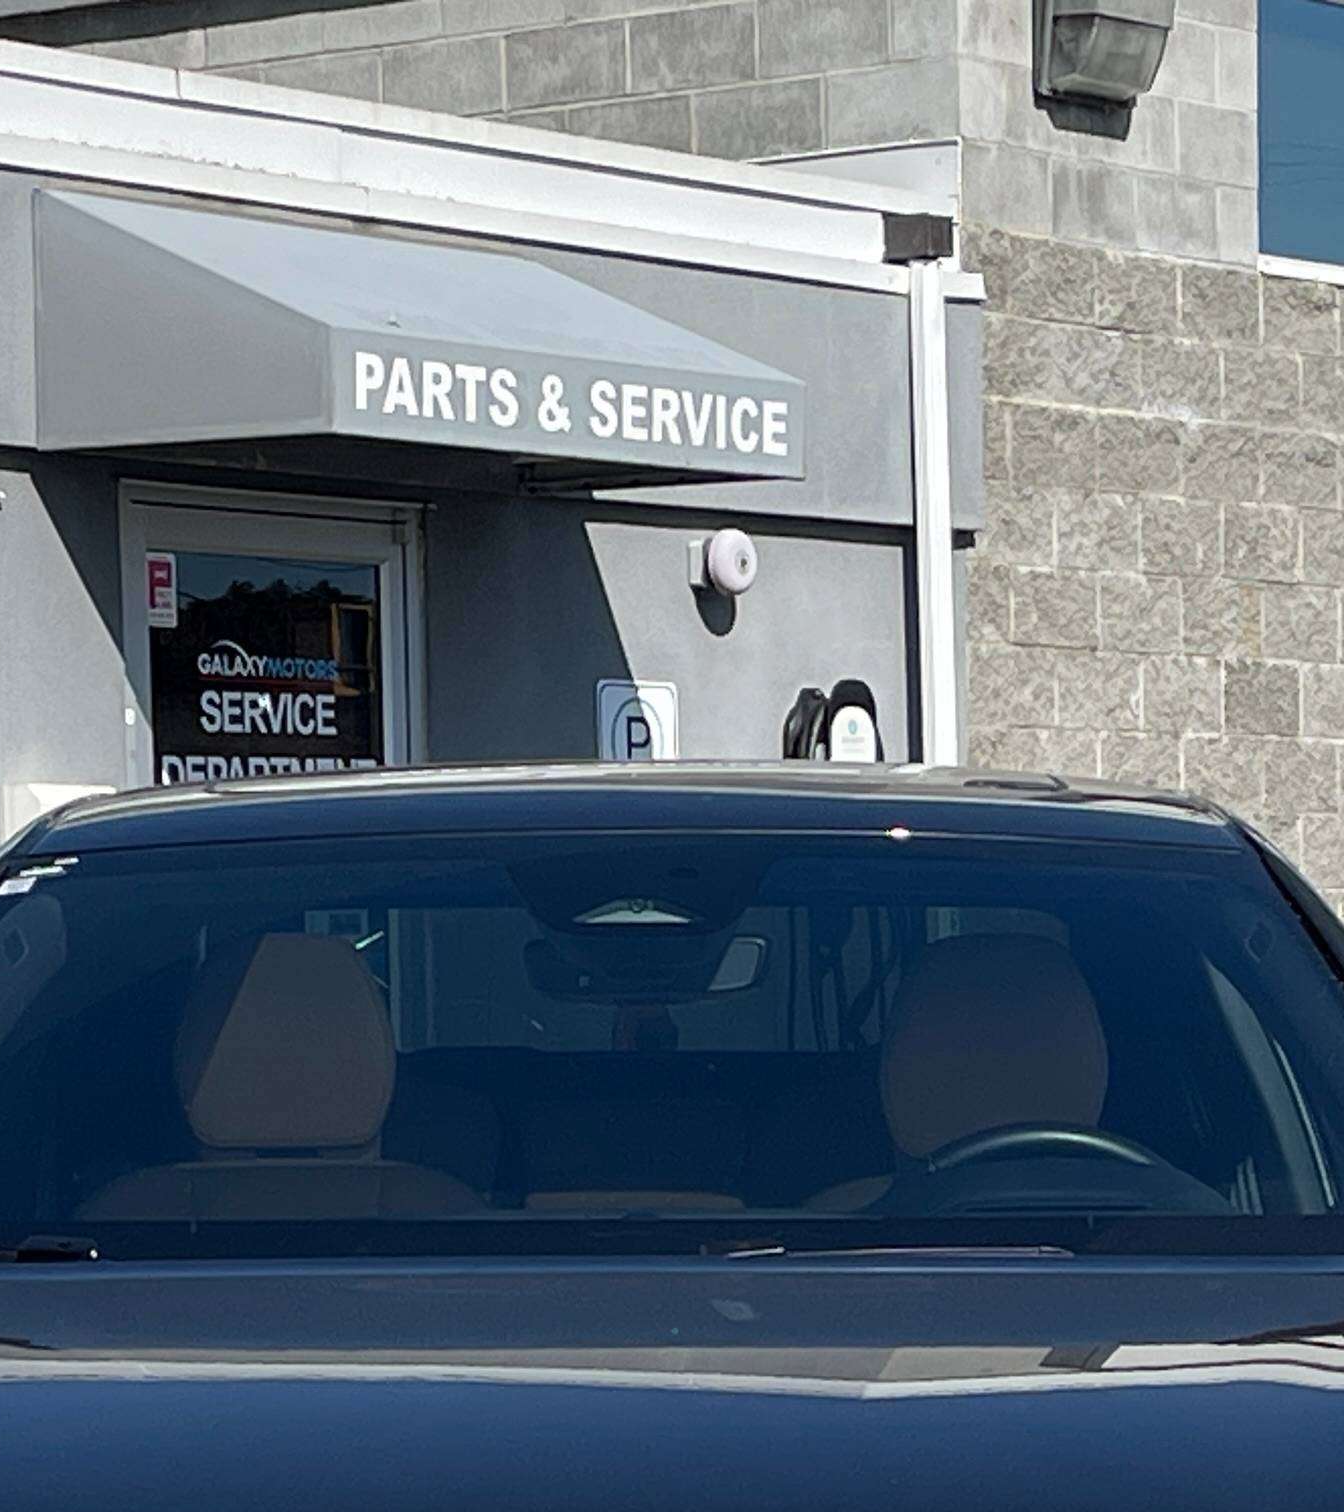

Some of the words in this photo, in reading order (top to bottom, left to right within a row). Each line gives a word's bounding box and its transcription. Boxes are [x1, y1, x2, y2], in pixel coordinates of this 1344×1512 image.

[356, 351, 520, 428] PARTS
[537, 374, 573, 433] &
[589, 379, 790, 456] SERVICE
[197, 641, 339, 681] GALAXYMOTORS
[199, 690, 339, 736] SERVICE
[162, 755, 379, 786] DEPAR
